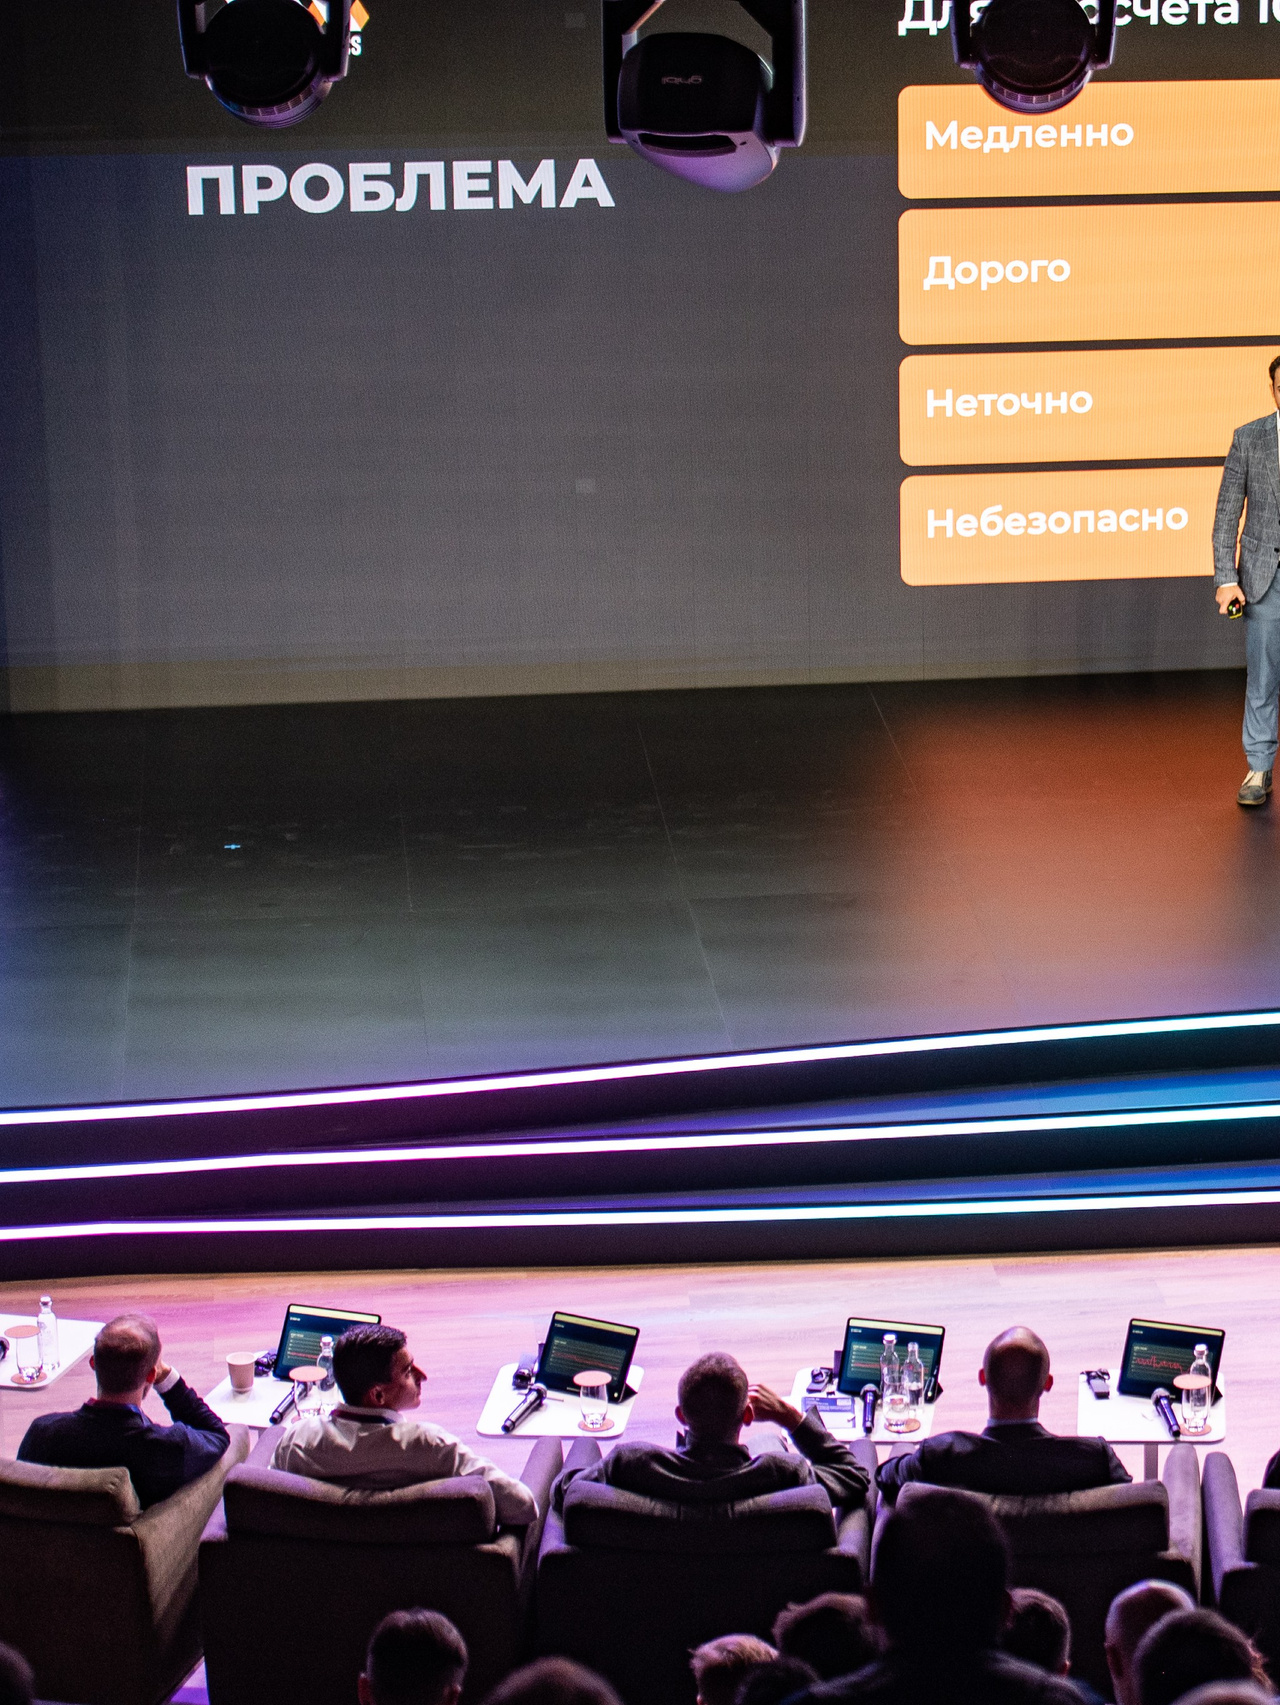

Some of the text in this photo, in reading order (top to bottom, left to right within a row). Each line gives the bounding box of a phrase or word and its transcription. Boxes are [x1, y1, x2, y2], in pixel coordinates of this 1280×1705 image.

[925, 120, 1135, 154] Медленно
[186, 158, 616, 216] ПРОБЛЕМА
[922, 255, 1071, 291] Дорого
[926, 388, 1094, 419] Неточно
[927, 503, 1189, 539] Небезопасно
